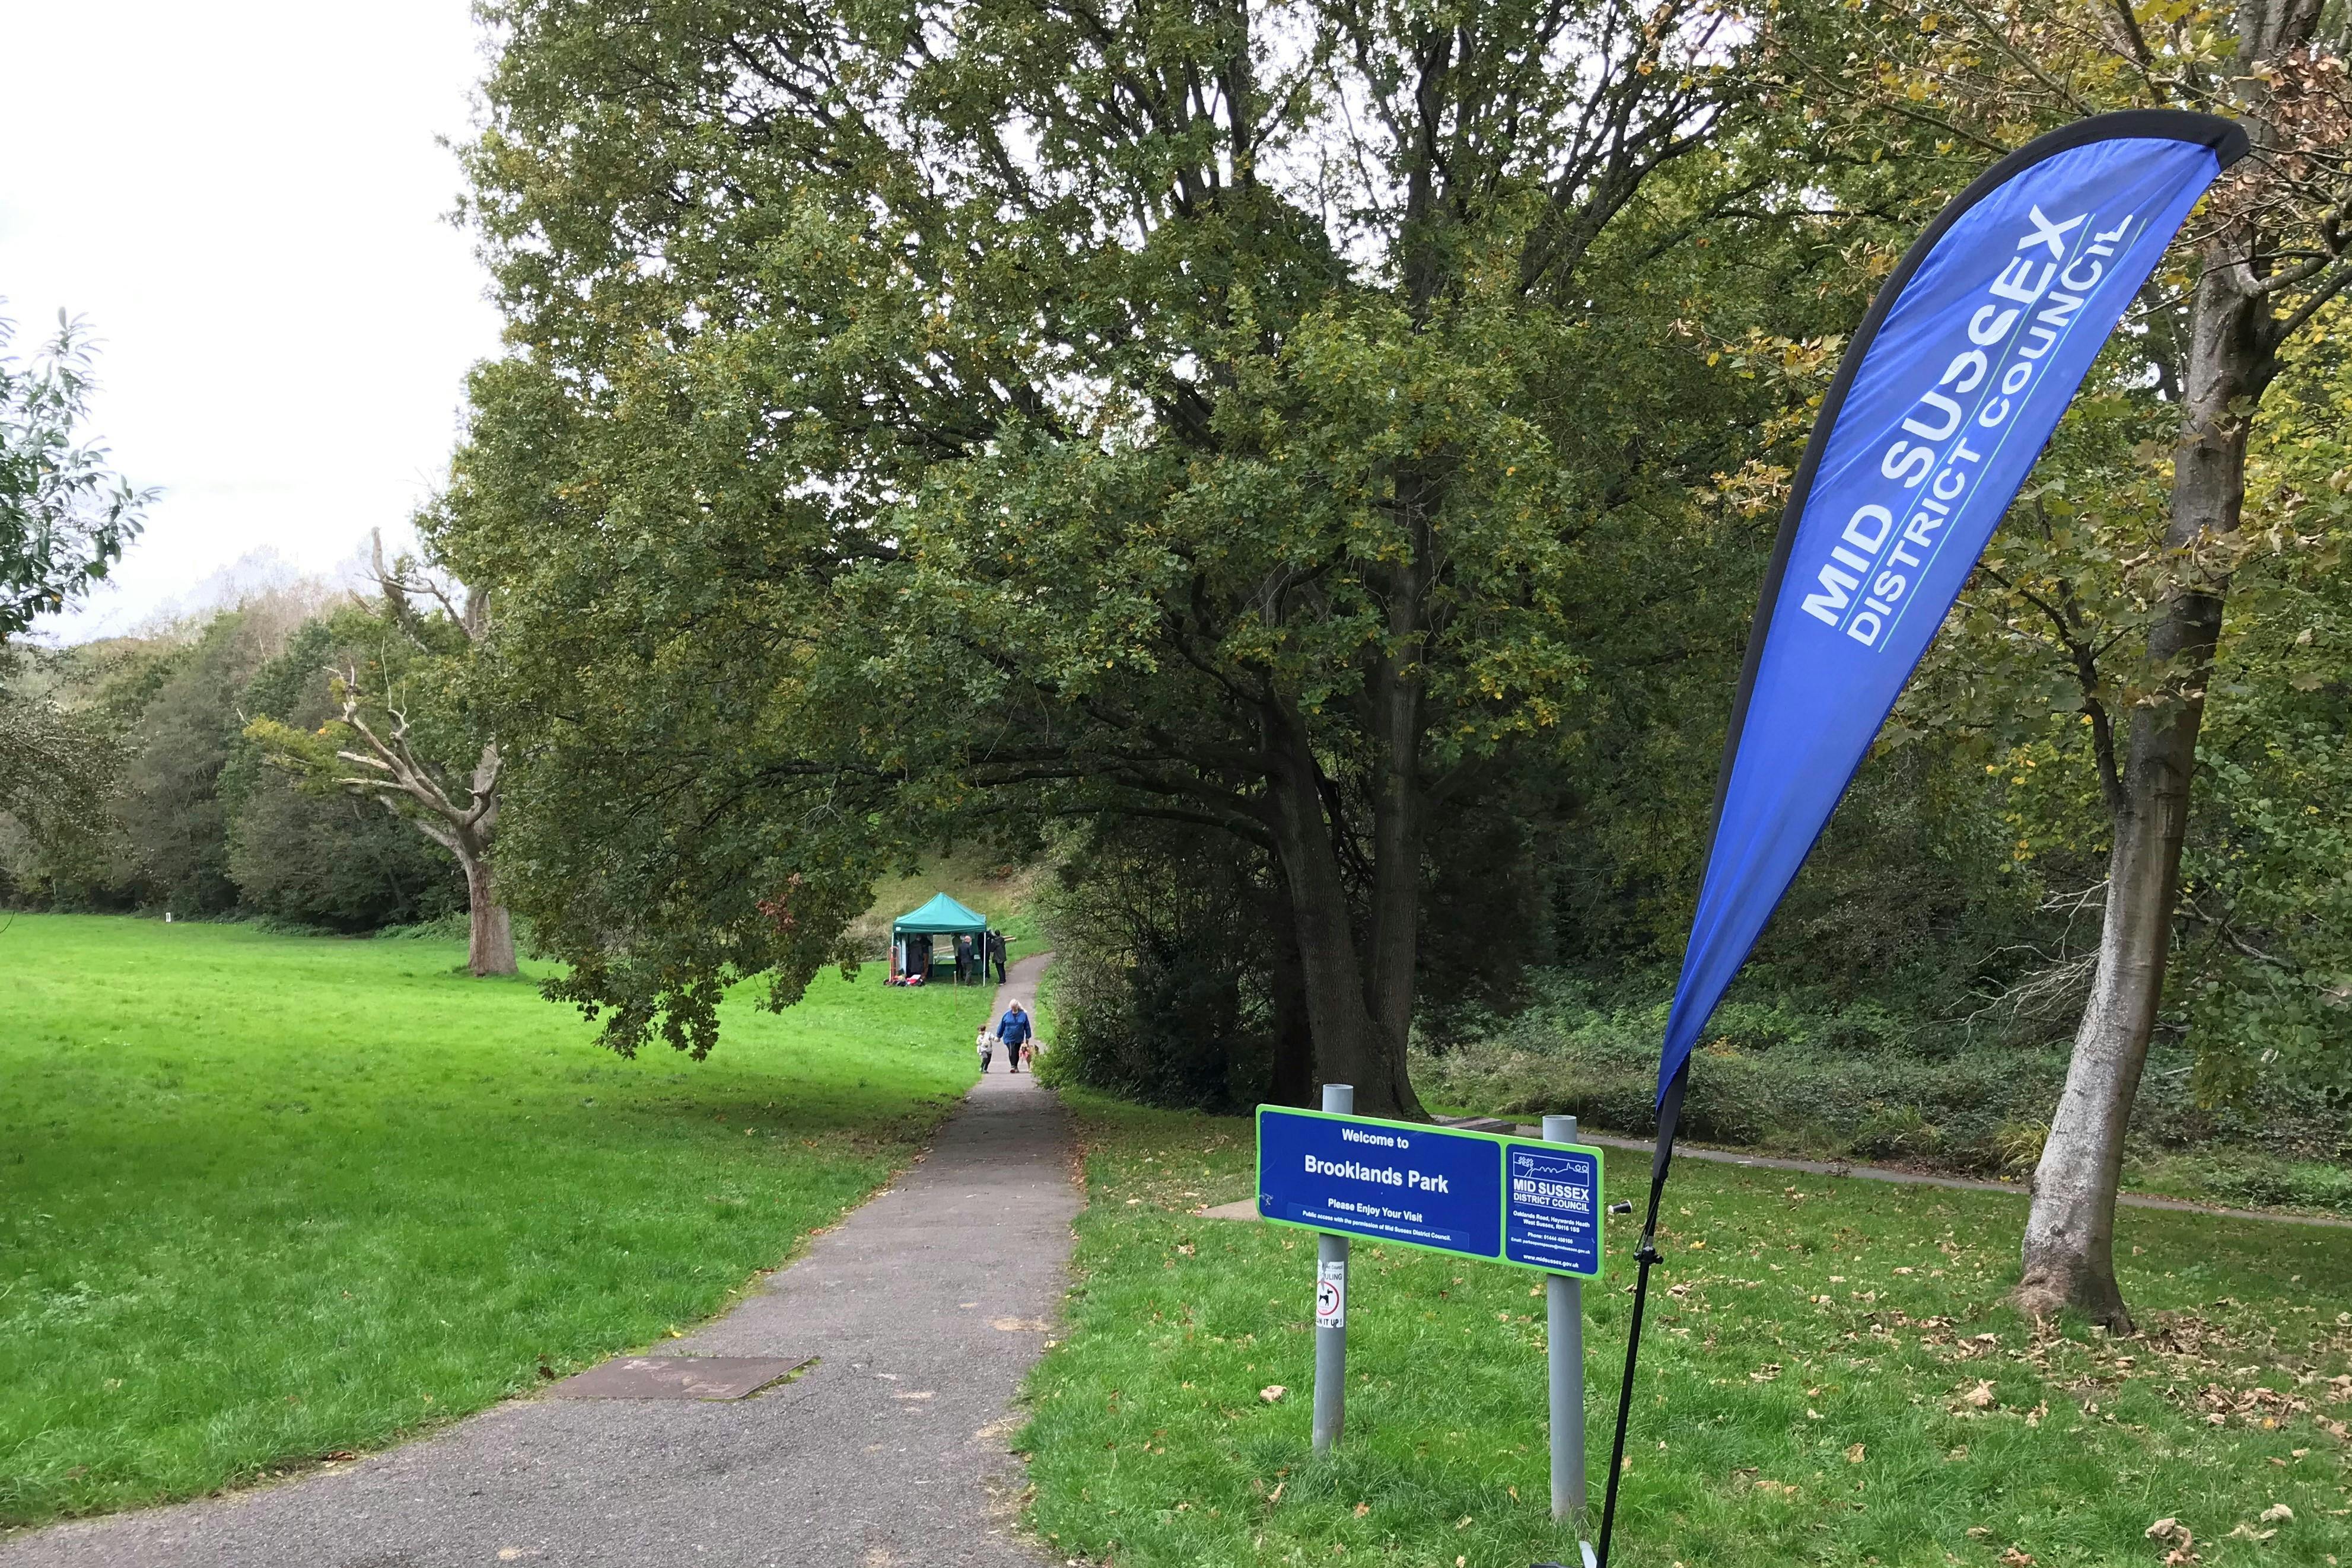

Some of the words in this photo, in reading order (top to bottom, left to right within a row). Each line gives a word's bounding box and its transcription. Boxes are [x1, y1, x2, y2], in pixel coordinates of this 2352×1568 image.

[1801, 504, 1892, 627] MID
[1881, 203, 2088, 488] SUSSEX
[1847, 437, 1981, 646] DISTRICT
[1979, 214, 2133, 427] COUNCIL
[1342, 1128, 1394, 1147] Welcome
[1397, 1136, 1409, 1149] to
[1304, 1155, 1402, 1186] Brooklands
[1408, 1169, 1449, 1193] Park
[1513, 1178, 1536, 1193] MID
[1538, 1182, 1589, 1201] SUSSEX
[1328, 1198, 1355, 1211] Please
[1357, 1203, 1380, 1217] Enjoy
[1382, 1207, 1402, 1219] Your
[1403, 1210, 1422, 1222] Visit
[1513, 1193, 1550, 1205] DISTRICT
[1552, 1199, 1589, 1212] COUNCIL
[1302, 1210, 1316, 1218] Public
[1352, 1220, 1378, 1229] permission
[1394, 1226, 1412, 1235] Sussex
[1412, 1229, 1430, 1238] District
[1431, 1232, 1452, 1241] Council.
[1513, 1210, 1535, 1219] Oaklands
[1551, 1216, 1575, 1225] Haywards
[1536, 1220, 1555, 1229] Sussex,
[1523, 1254, 1579, 1268] www.midsussex.gov.uk
